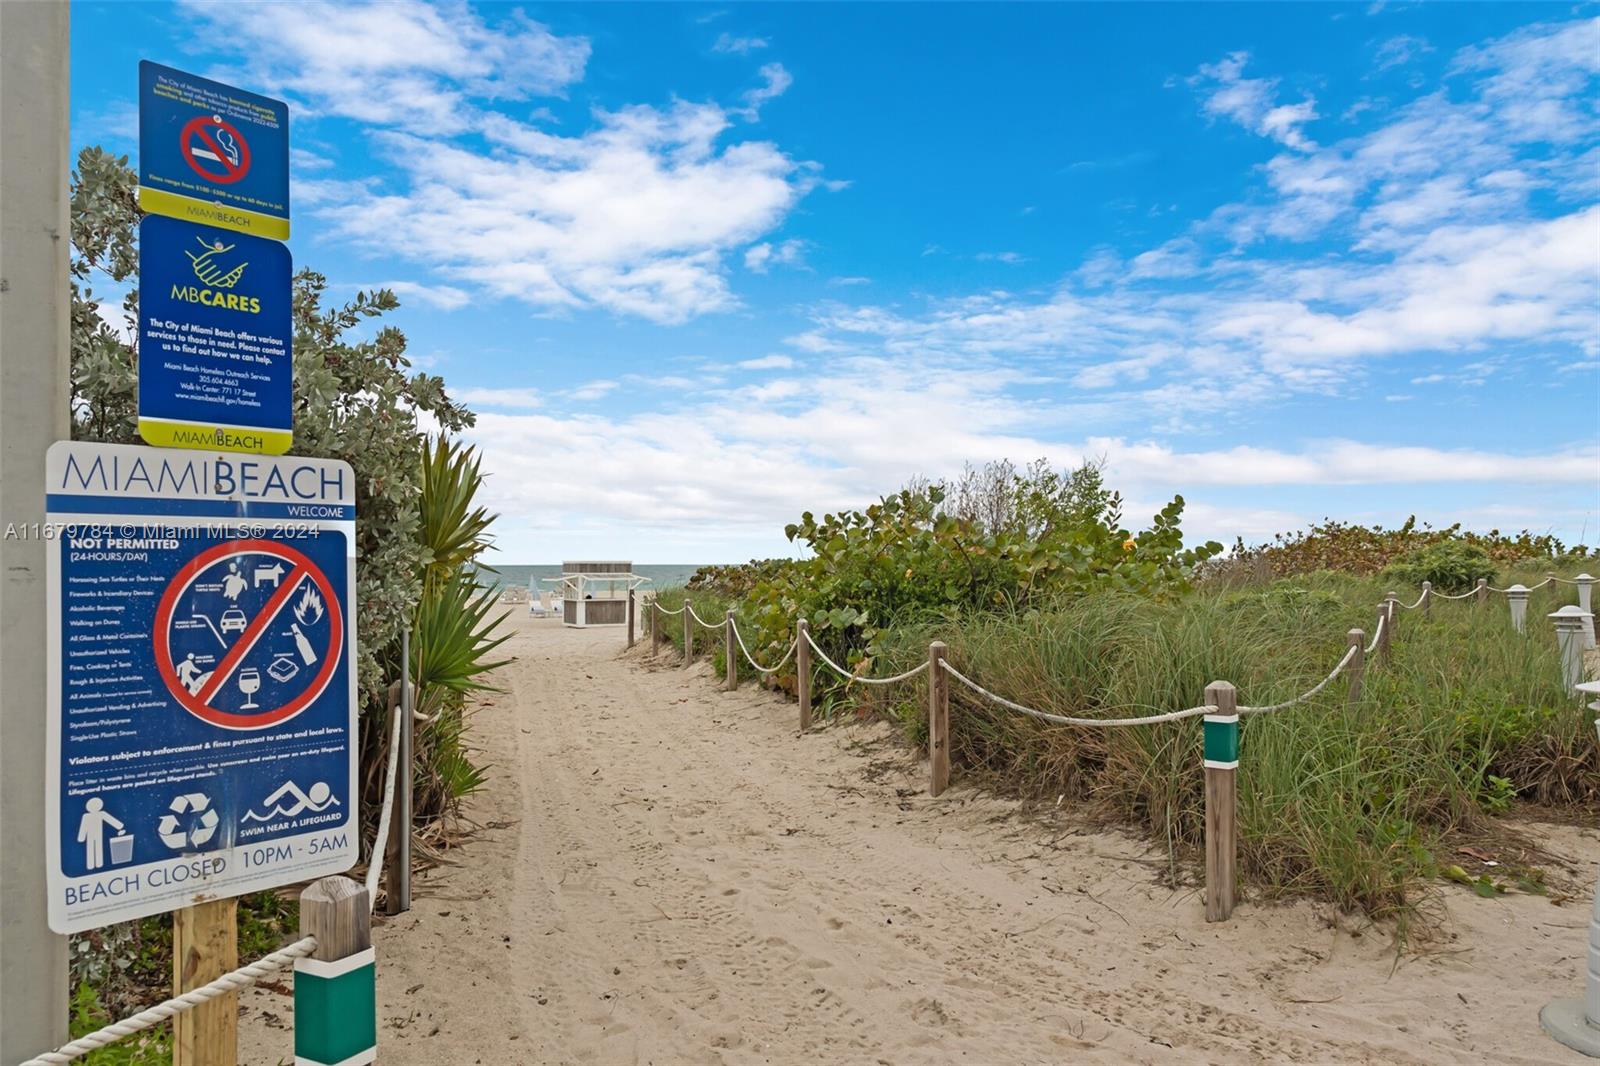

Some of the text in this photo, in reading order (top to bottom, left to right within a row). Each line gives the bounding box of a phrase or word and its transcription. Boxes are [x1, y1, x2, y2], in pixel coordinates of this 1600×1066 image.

[186, 206, 250, 227] MIAMIBEACH
[170, 284, 260, 314] MBCARES
[147, 330, 177, 340] services
[187, 334, 207, 345] those
[208, 337, 216, 346] in
[217, 340, 237, 349] need.
[238, 342, 260, 352] Please
[262, 347, 286, 356] contact
[150, 318, 283, 346] The City of Miami Beach offers various
[182, 344, 197, 354] find
[212, 348, 228, 358] how
[242, 354, 254, 362] can
[255, 354, 272, 366] help.
[164, 362, 271, 382] Miami Beach Homeless Outreach Services
[222, 387, 232, 395] 771
[242, 389, 256, 397] Street
[172, 431, 263, 448] MIAMIBEACH
[62, 452, 343, 500] MIAMIBEACH
[288, 505, 344, 518] WELCOME
[70, 539, 179, 550] NOT PERMITTED
[70, 551, 148, 562] (24-HOURS/DAY)
[69, 755, 109, 765] Violators
[111, 752, 141, 761] subject
[153, 744, 203, 756] enforcement
[213, 740, 231, 748] fines
[232, 736, 265, 747] pursuant
[276, 733, 293, 741] state
[294, 730, 308, 738] and
[309, 728, 325, 736] local
[68, 786, 101, 796] Lifeguard
[134, 778, 156, 788] posted
[167, 773, 195, 783] lifeguard
[196, 770, 217, 778] stands.
[240, 826, 265, 838] SWIM
[266, 822, 290, 833] NEAR
[300, 812, 342, 827] LIFEGUARD
[65, 873, 139, 906] BEACH
[147, 857, 227, 888] CLOSED
[243, 843, 293, 868] 10PM
[308, 833, 348, 855] 5AM
